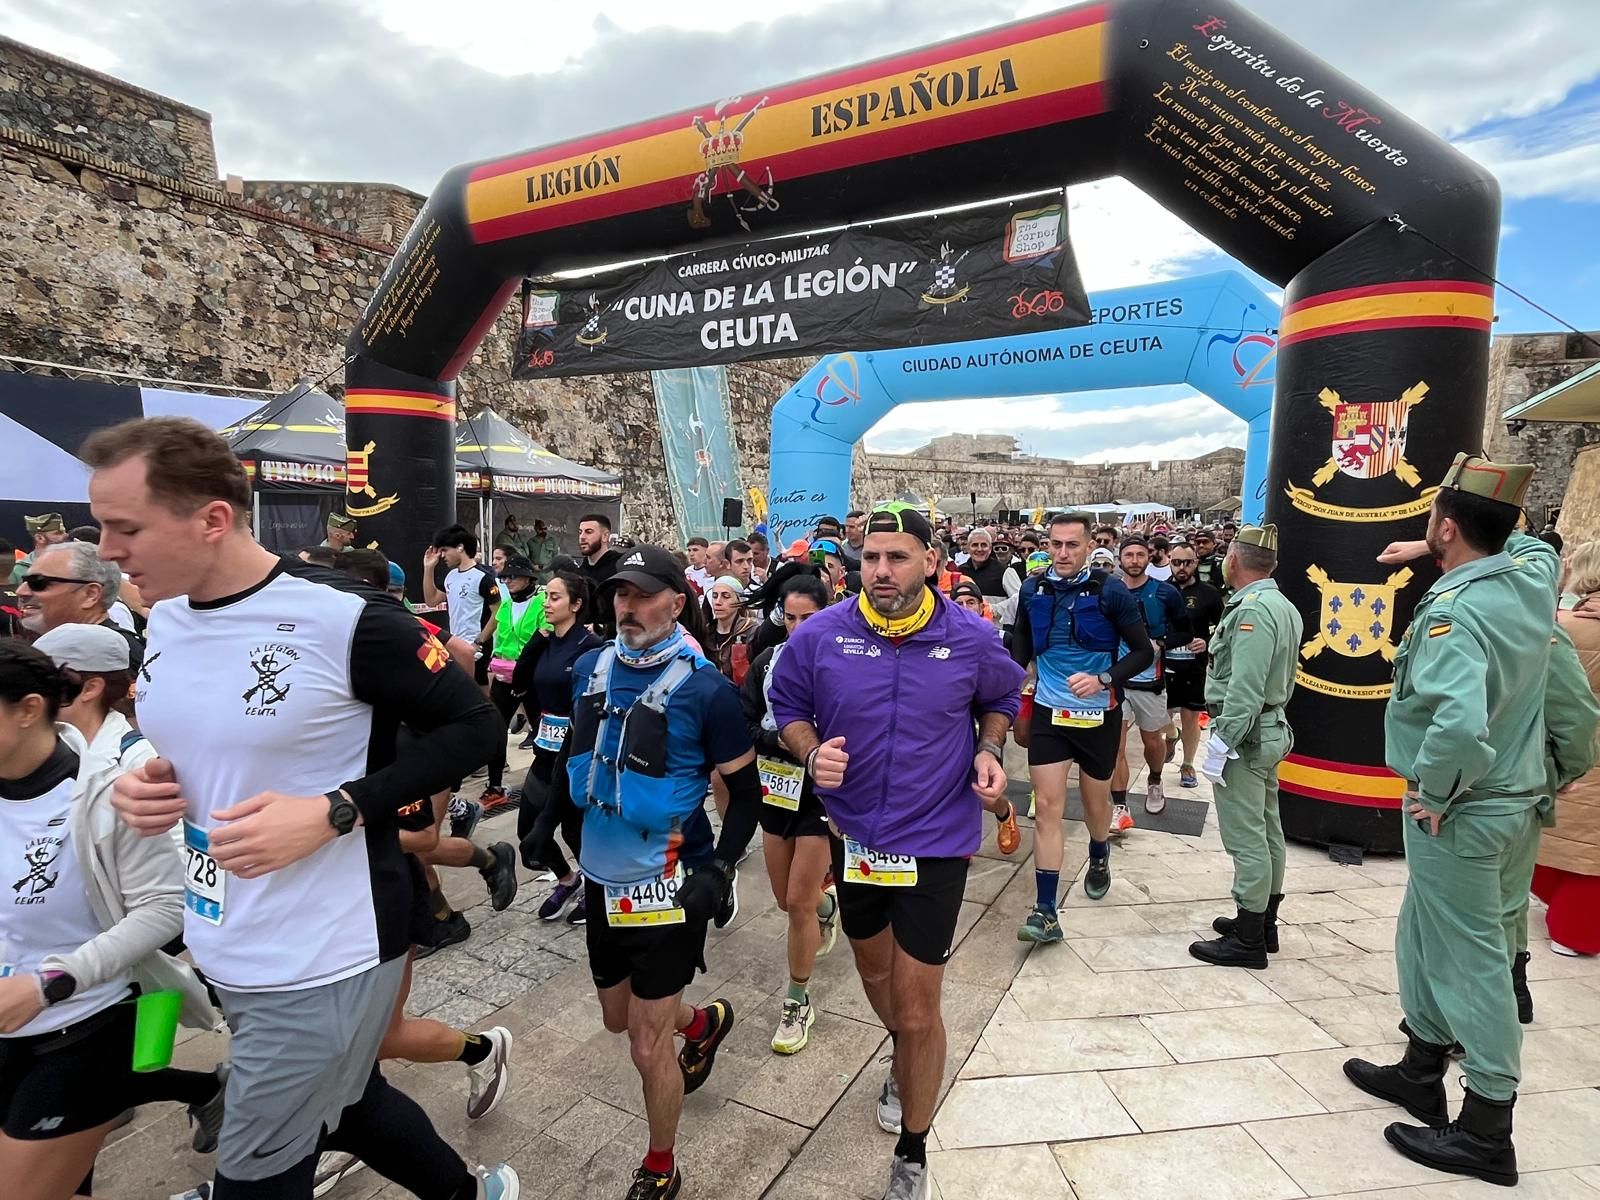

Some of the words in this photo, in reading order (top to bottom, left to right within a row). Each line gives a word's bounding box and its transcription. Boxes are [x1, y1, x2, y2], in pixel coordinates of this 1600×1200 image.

[1165, 42, 1192, 66] El
[1183, 54, 1214, 82] morir
[1211, 79, 1228, 92] en
[1225, 88, 1246, 103] el
[1236, 91, 1281, 128] combate
[1278, 125, 1294, 137] es
[1291, 134, 1314, 149] el
[1303, 142, 1342, 169] mayor
[1192, 16, 1275, 78] Espíritu
[1274, 76, 1305, 96] de
[1297, 89, 1325, 108] la
[1322, 101, 1407, 166] Muerte
[526, 154, 622, 204] LEGIÓN
[810, 58, 1018, 138] ESPAÑOLA
[1178, 74, 1208, 98] No
[1197, 95, 1212, 107] se
[1209, 103, 1244, 129] muere
[1241, 126, 1266, 144] más
[1259, 142, 1286, 166] que
[1285, 156, 1310, 176] una
[1152, 81, 1174, 106] La
[1171, 102, 1208, 130] muerte
[1206, 123, 1234, 148] llega
[1232, 146, 1252, 162] sin
[1250, 152, 1280, 180] dolor
[1270, 175, 1291, 192] y
[1288, 185, 1310, 200] el
[1299, 187, 1333, 217] morir
[1153, 114, 1169, 127] no
[1168, 124, 1181, 135] es
[1179, 131, 1199, 149] tan
[1197, 143, 1240, 178] horrible
[1238, 175, 1265, 196] como
[1144, 122, 1162, 144] Lo
[1161, 142, 1183, 160] más
[1181, 154, 1223, 188] horrible
[1220, 186, 1234, 197] es
[1234, 194, 1260, 214] vivir
[1259, 214, 1296, 240] siendo
[1018, 222, 1038, 234] The
[678, 259, 730, 278] CARRERA
[733, 243, 830, 270] CÍVICO-MILITAR
[1015, 240, 1045, 253] Shop
[703, 286, 736, 312] DE
[742, 280, 775, 306] LA
[700, 312, 798, 350] CEUTA
[902, 353, 962, 373] CIUDAD
[965, 344, 1066, 369] AUTÓNOMA
[1070, 341, 1094, 360] DE
[1098, 335, 1163, 357] CEUTA
[261, 460, 336, 483] TERCIO
[810, 492, 828, 502] es
[1294, 496, 1311, 509] TERCIO
[1326, 509, 1344, 517] JUAN
[1408, 505, 1418, 513] LA
[250, 647, 261, 658] LA
[264, 643, 301, 661] LEGION
[245, 706, 276, 717] CEUTA
[549, 726, 566, 739] 123
[770, 775, 800, 794] 5817
[25, 840, 35, 850] LA
[187, 847, 217, 888] 728
[14, 896, 45, 905] CEUTA
[632, 879, 678, 905] 4409
